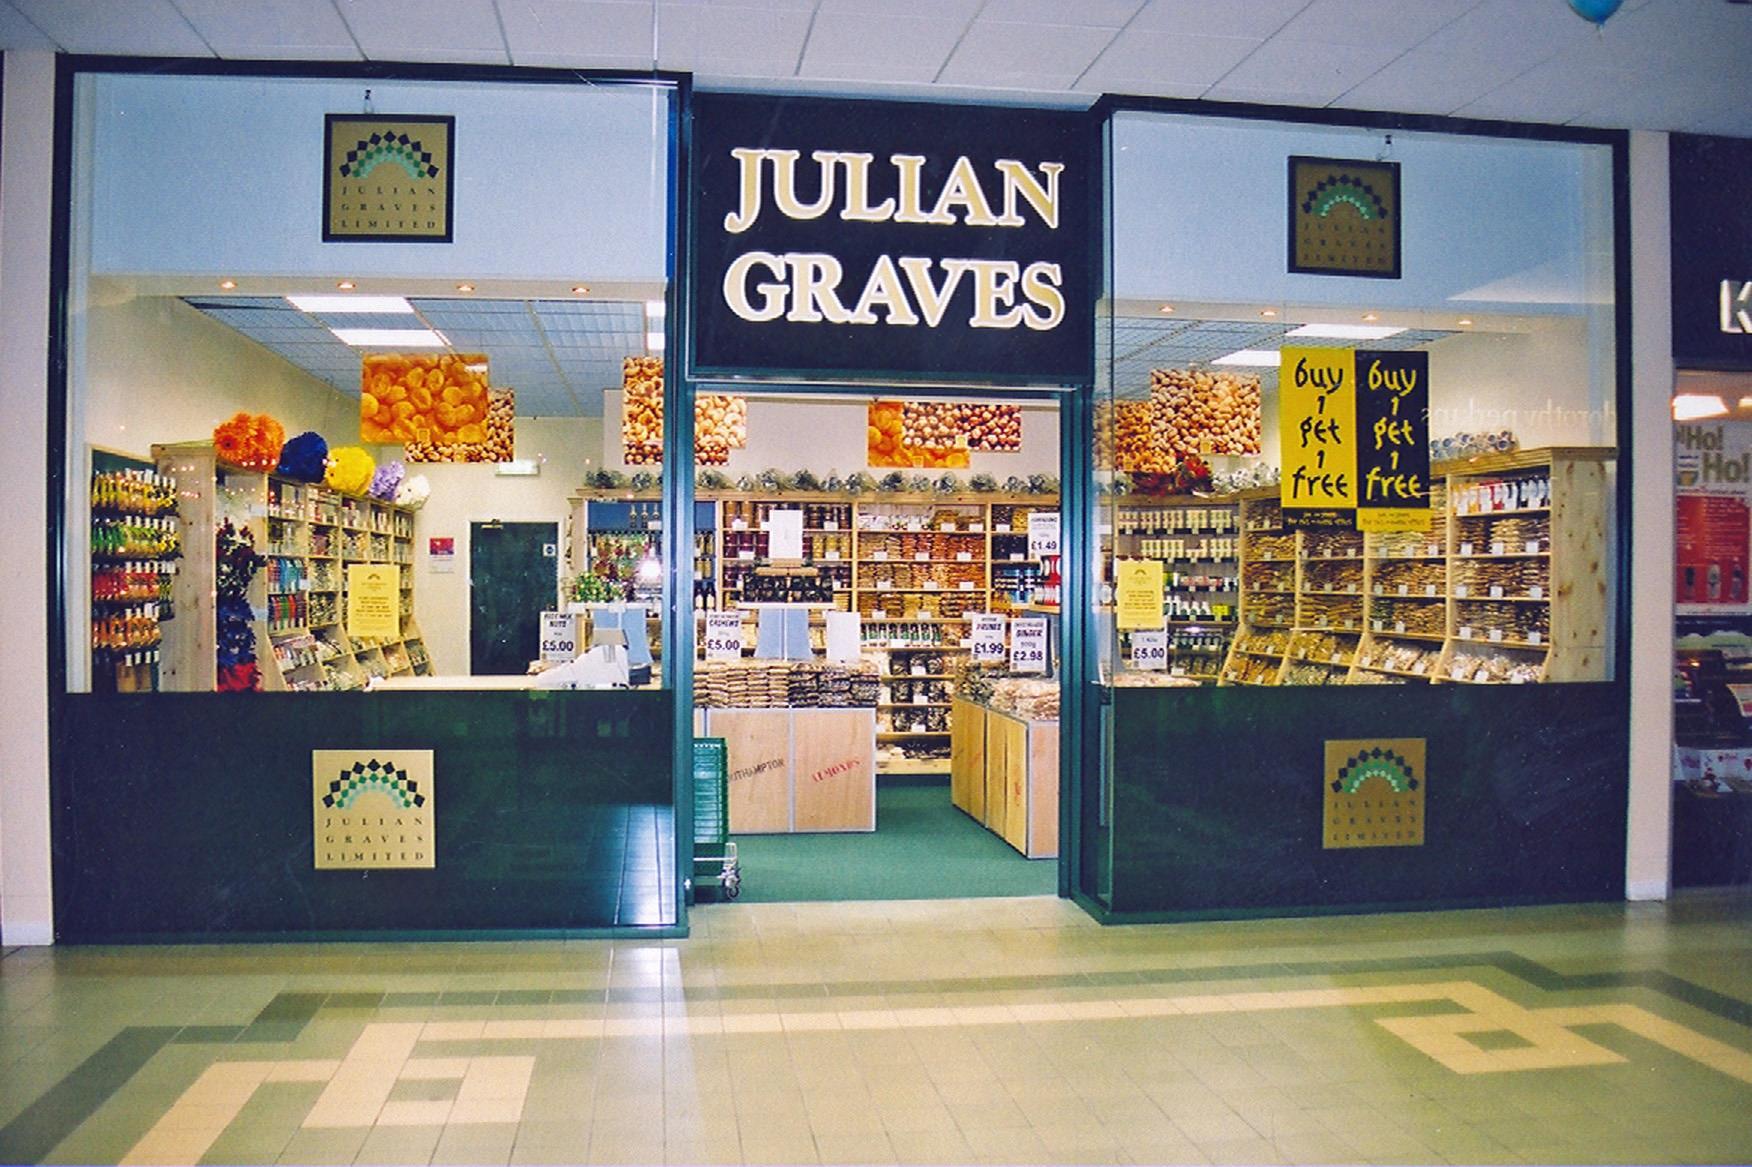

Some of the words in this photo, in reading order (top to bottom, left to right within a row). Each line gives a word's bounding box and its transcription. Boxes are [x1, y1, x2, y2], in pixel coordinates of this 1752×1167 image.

[341, 186, 436, 195] JULIAN
[724, 148, 1065, 233] JULIAN
[341, 203, 436, 211] GRAVES
[341, 220, 436, 229] LIMITED
[723, 251, 1066, 331] GRAVES
[1295, 357, 1343, 394] buy
[1368, 359, 1417, 396] buy
[1317, 395, 1326, 414] 1
[1391, 396, 1399, 416] 1
[1300, 416, 1342, 448] get
[1373, 416, 1415, 450] get
[1686, 425, 1724, 451] Ho!
[1316, 450, 1325, 469] 1
[1390, 450, 1399, 471] 1
[1702, 452, 1750, 483] Ho!
[1292, 465, 1348, 499] free
[1366, 466, 1421, 500] free
[1031, 540, 1057, 550] £1.49
[542, 640, 574, 652] £5.00
[707, 639, 740, 651] £5.00
[974, 642, 1004, 654] £1.99
[1134, 647, 1165, 659] £5.00
[1013, 650, 1043, 661] £2.98
[730, 758, 785, 782] UTHAMPTON
[326, 818, 422, 828] JULIAN
[326, 835, 423, 844] GRAVES
[327, 852, 424, 861] LIMITED
